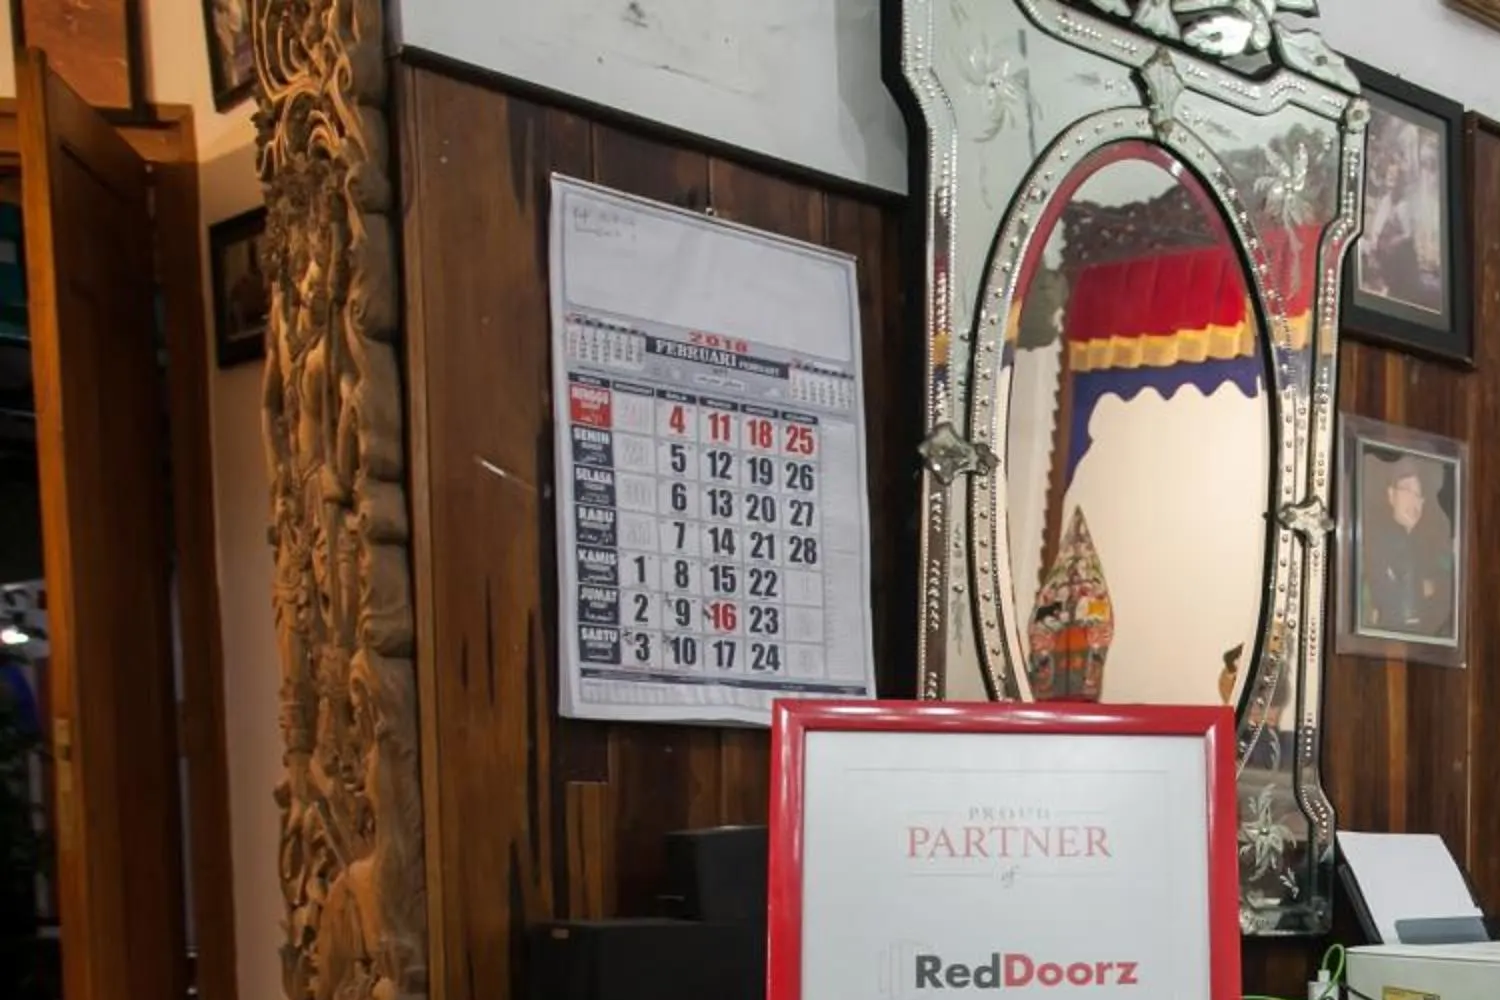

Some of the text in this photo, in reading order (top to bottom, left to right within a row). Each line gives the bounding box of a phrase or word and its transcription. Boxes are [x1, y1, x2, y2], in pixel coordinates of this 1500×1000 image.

[688, 330, 750, 354] 2018
[669, 405, 686, 434] 4
[708, 411, 731, 441] 11
[747, 418, 773, 449] 18
[785, 424, 814, 455] 25
[670, 443, 687, 473] 5
[707, 450, 732, 480] 12
[747, 456, 774, 486] 19
[785, 461, 814, 491] 26
[671, 482, 687, 511] 6
[707, 488, 733, 518] 13
[745, 493, 776, 523] 20
[789, 499, 814, 527] 27
[673, 521, 686, 549] 7
[708, 526, 736, 556] 14
[750, 531, 776, 561] 21
[789, 535, 817, 565] 28
[633, 555, 646, 583] 1
[674, 559, 689, 588] 8
[709, 564, 737, 593] 15
[749, 567, 778, 597] 22
[633, 593, 649, 622] 2
[675, 597, 691, 627] 9
[710, 602, 737, 631] 16
[749, 605, 779, 634] 23
[634, 632, 650, 662] 3
[670, 636, 697, 665] 10
[712, 639, 737, 668] 17
[751, 642, 781, 671] 24
[907, 824, 1113, 859] PARTNER
[914, 952, 1139, 989] RedDoorz
